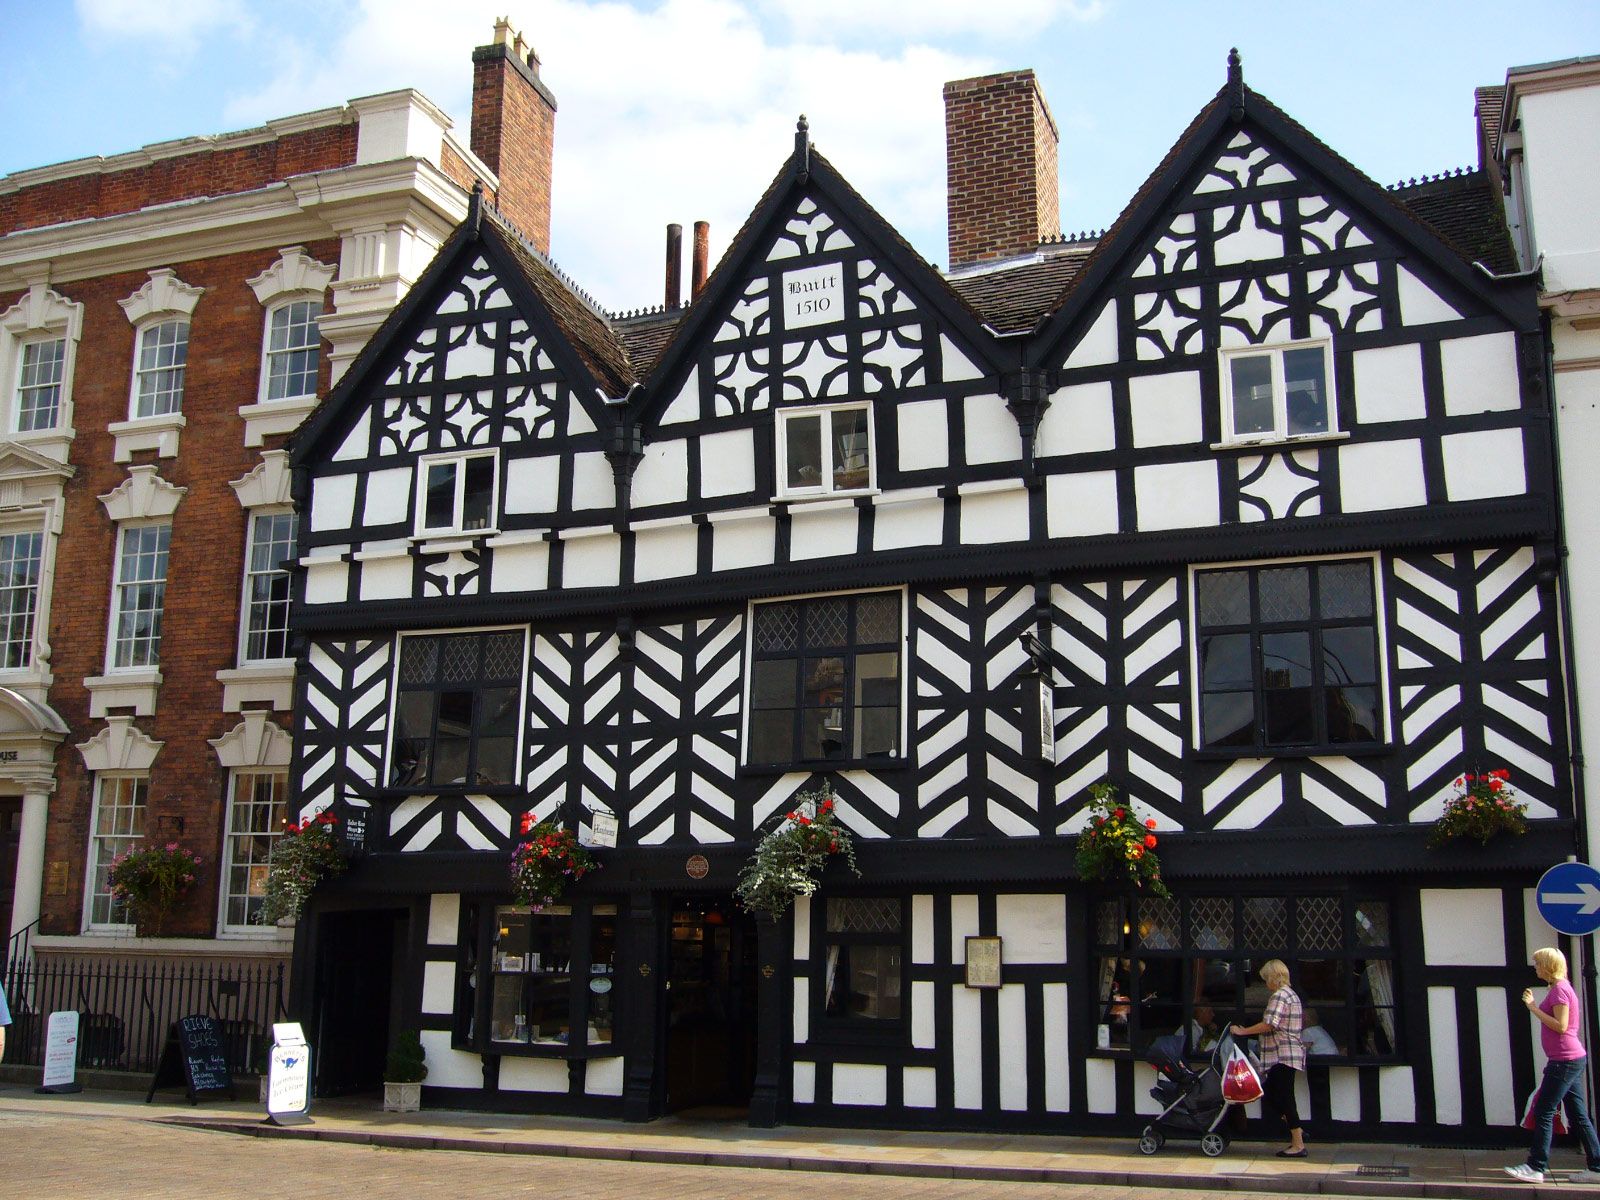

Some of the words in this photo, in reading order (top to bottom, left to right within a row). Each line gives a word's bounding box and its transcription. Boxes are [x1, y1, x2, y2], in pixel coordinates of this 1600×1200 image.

[787, 275, 837, 295] Built
[796, 297, 831, 316] 1510
[188, 1031, 218, 1049] SHOES
